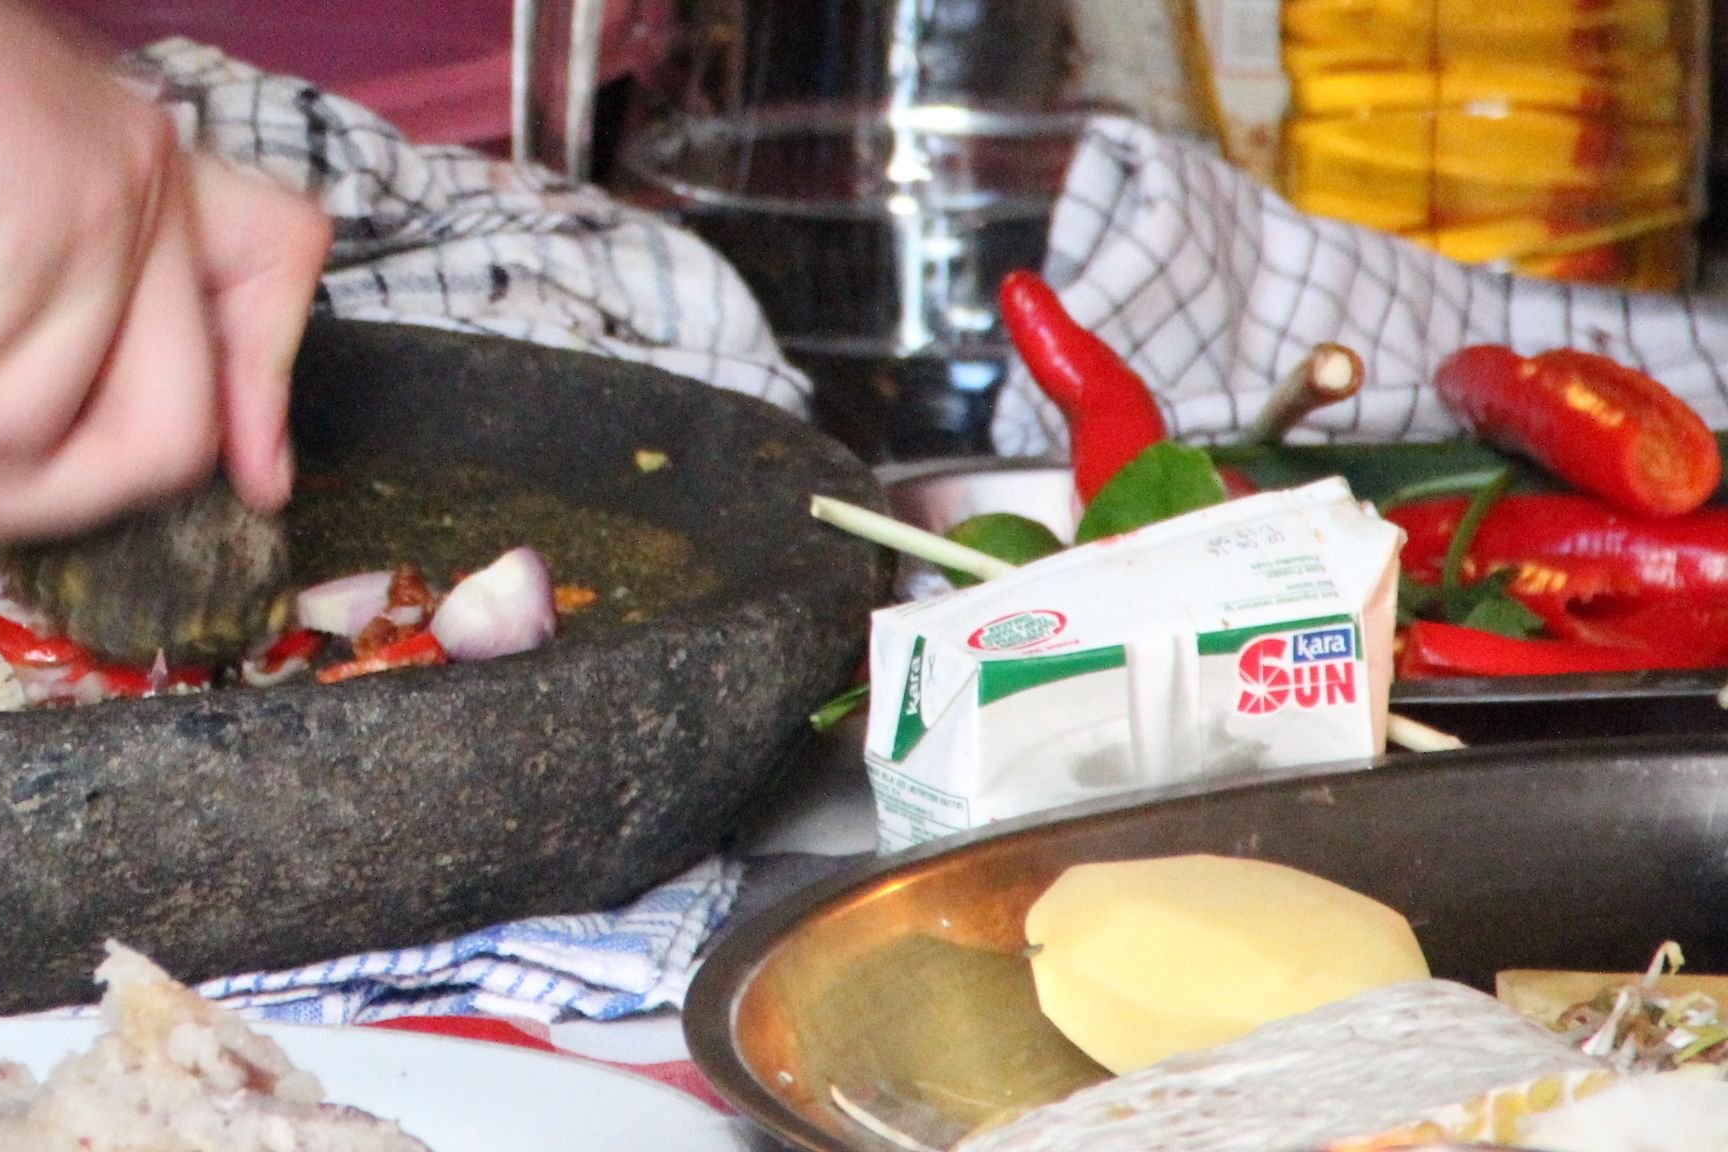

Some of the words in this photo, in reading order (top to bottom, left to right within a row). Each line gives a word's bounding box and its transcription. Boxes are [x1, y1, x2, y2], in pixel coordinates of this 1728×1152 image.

[1237, 637, 1357, 715] SUN
[1296, 633, 1347, 661] kara
[905, 654, 922, 716] kara
